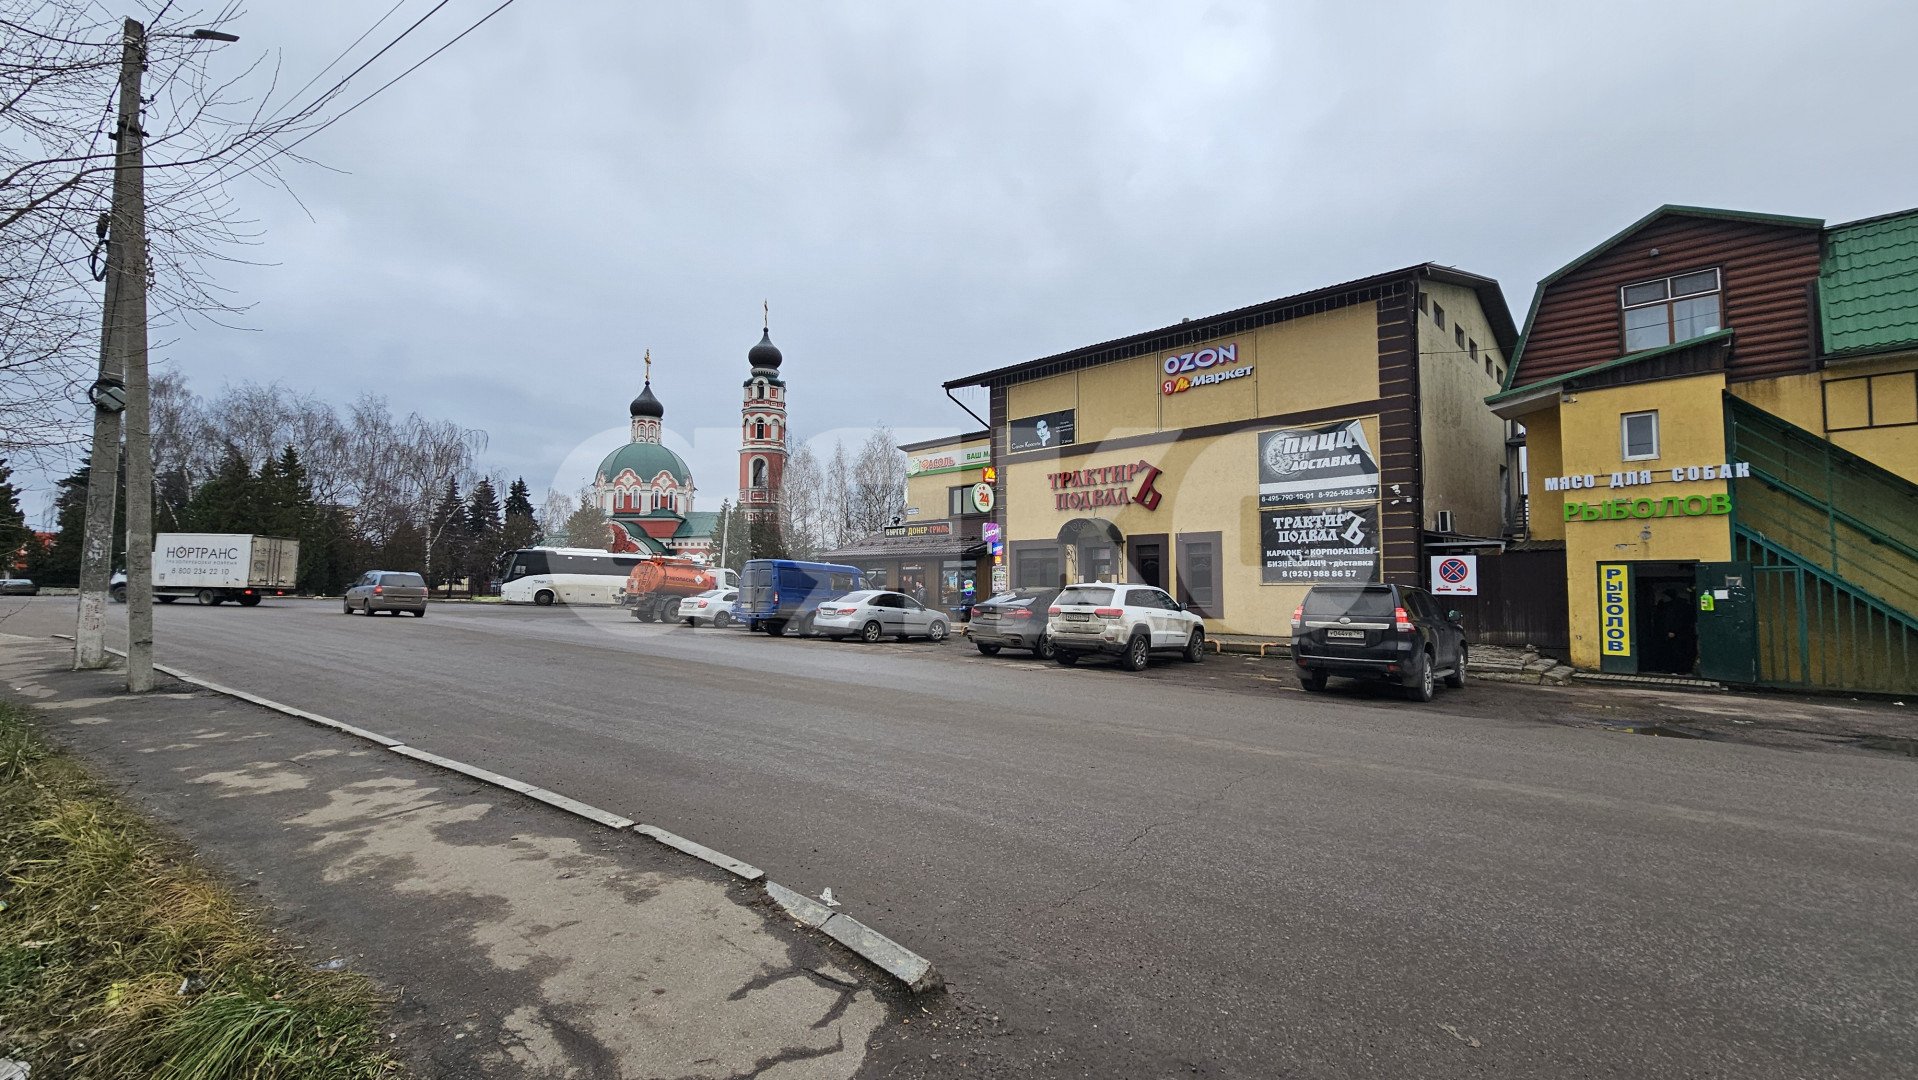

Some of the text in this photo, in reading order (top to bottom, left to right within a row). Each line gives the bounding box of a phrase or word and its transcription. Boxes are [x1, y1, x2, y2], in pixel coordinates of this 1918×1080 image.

[1164, 343, 1238, 375] OZON
[1191, 365, 1254, 386] Маркет
[1283, 429, 1359, 454] ПИЦЦ
[967, 451, 981, 460] ВАШ
[1291, 454, 1361, 471] ДОСТАВКА
[1545, 462, 1750, 491] МЯСО ДЛЯ СОБАК
[979, 492, 989, 506] 24
[1261, 487, 1376, 502] 8-495-790-10-01 8-926-988-86-57
[1564, 493, 1732, 521] РЫБОЛОВ
[886, 525, 949, 536] БУРГЕР ДОНЕР ГРИЛЬ
[1278, 528, 1339, 544] ПОДВАЛ
[167, 546, 238, 560] НОРТРАНС
[1310, 547, 1374, 556] КОРПОРАТИВЫ
[1333, 560, 1373, 568] доставка
[1289, 570, 1311, 578] (926)
[1605, 568, 1625, 652] РЫБОЛОВ
